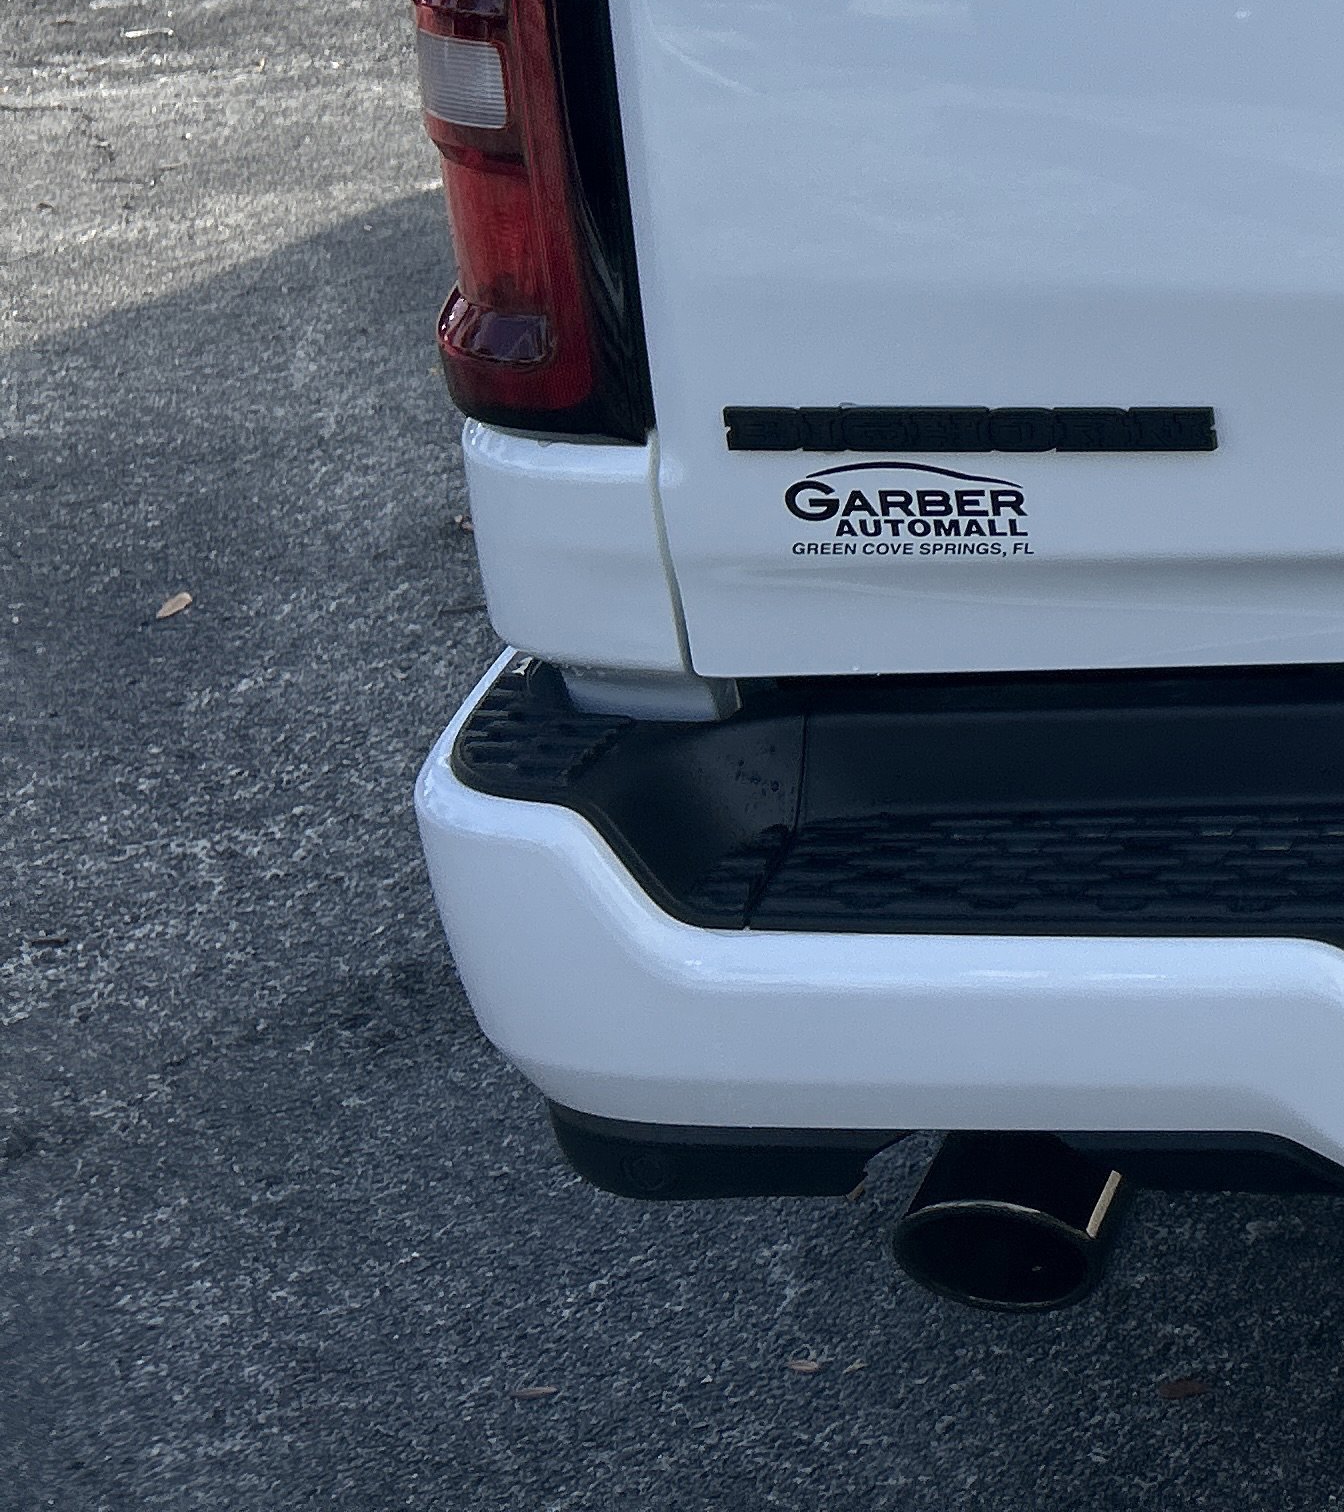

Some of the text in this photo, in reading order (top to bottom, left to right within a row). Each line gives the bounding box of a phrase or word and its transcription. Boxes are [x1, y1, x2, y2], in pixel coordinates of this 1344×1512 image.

[784, 480, 1028, 522] GARBER
[835, 518, 1029, 538] AUTOMALL
[791, 542, 1035, 558] GREEN COVE SPRINGS, FL
